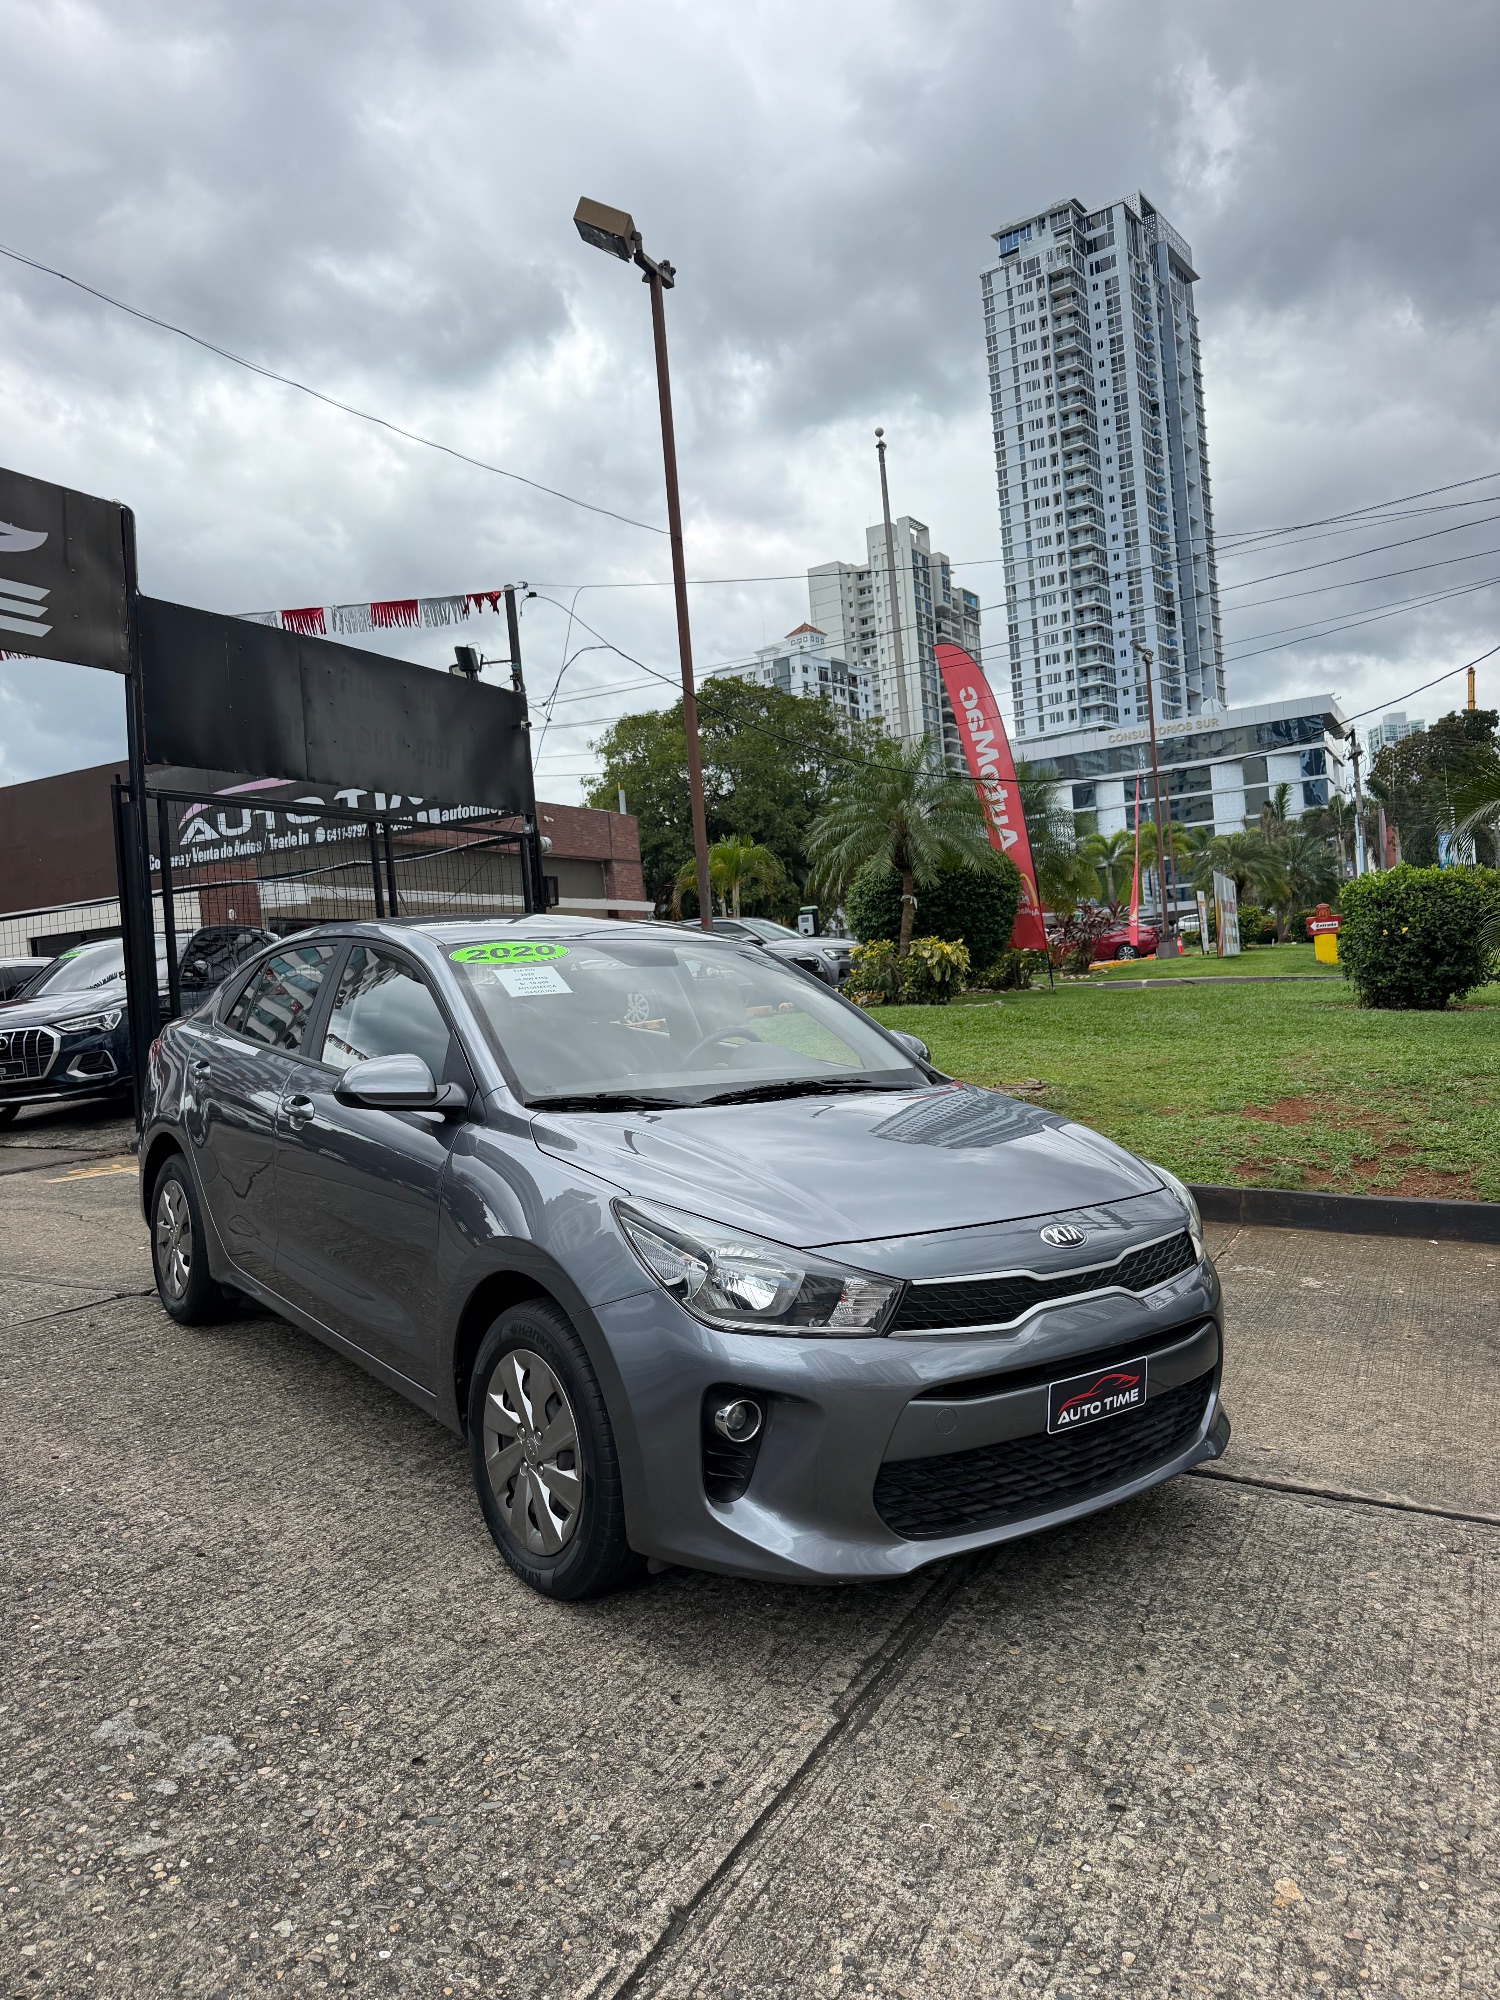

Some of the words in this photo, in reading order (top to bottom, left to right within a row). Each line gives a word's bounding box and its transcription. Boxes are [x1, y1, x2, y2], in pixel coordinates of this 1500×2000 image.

[1108, 721, 1193, 743] CONSULORIOS
[1196, 717, 1220, 729] SUR
[185, 853, 192, 868] y
[192, 845, 220, 863] Venta
[220, 842, 233, 858] de
[234, 839, 263, 856] Autos
[269, 831, 297, 850] Trade
[466, 945, 556, 961] 2020
[1047, 1226, 1084, 1243] KIA
[1057, 1401, 1101, 1425] AUTO
[1104, 1388, 1139, 1411] TIME
